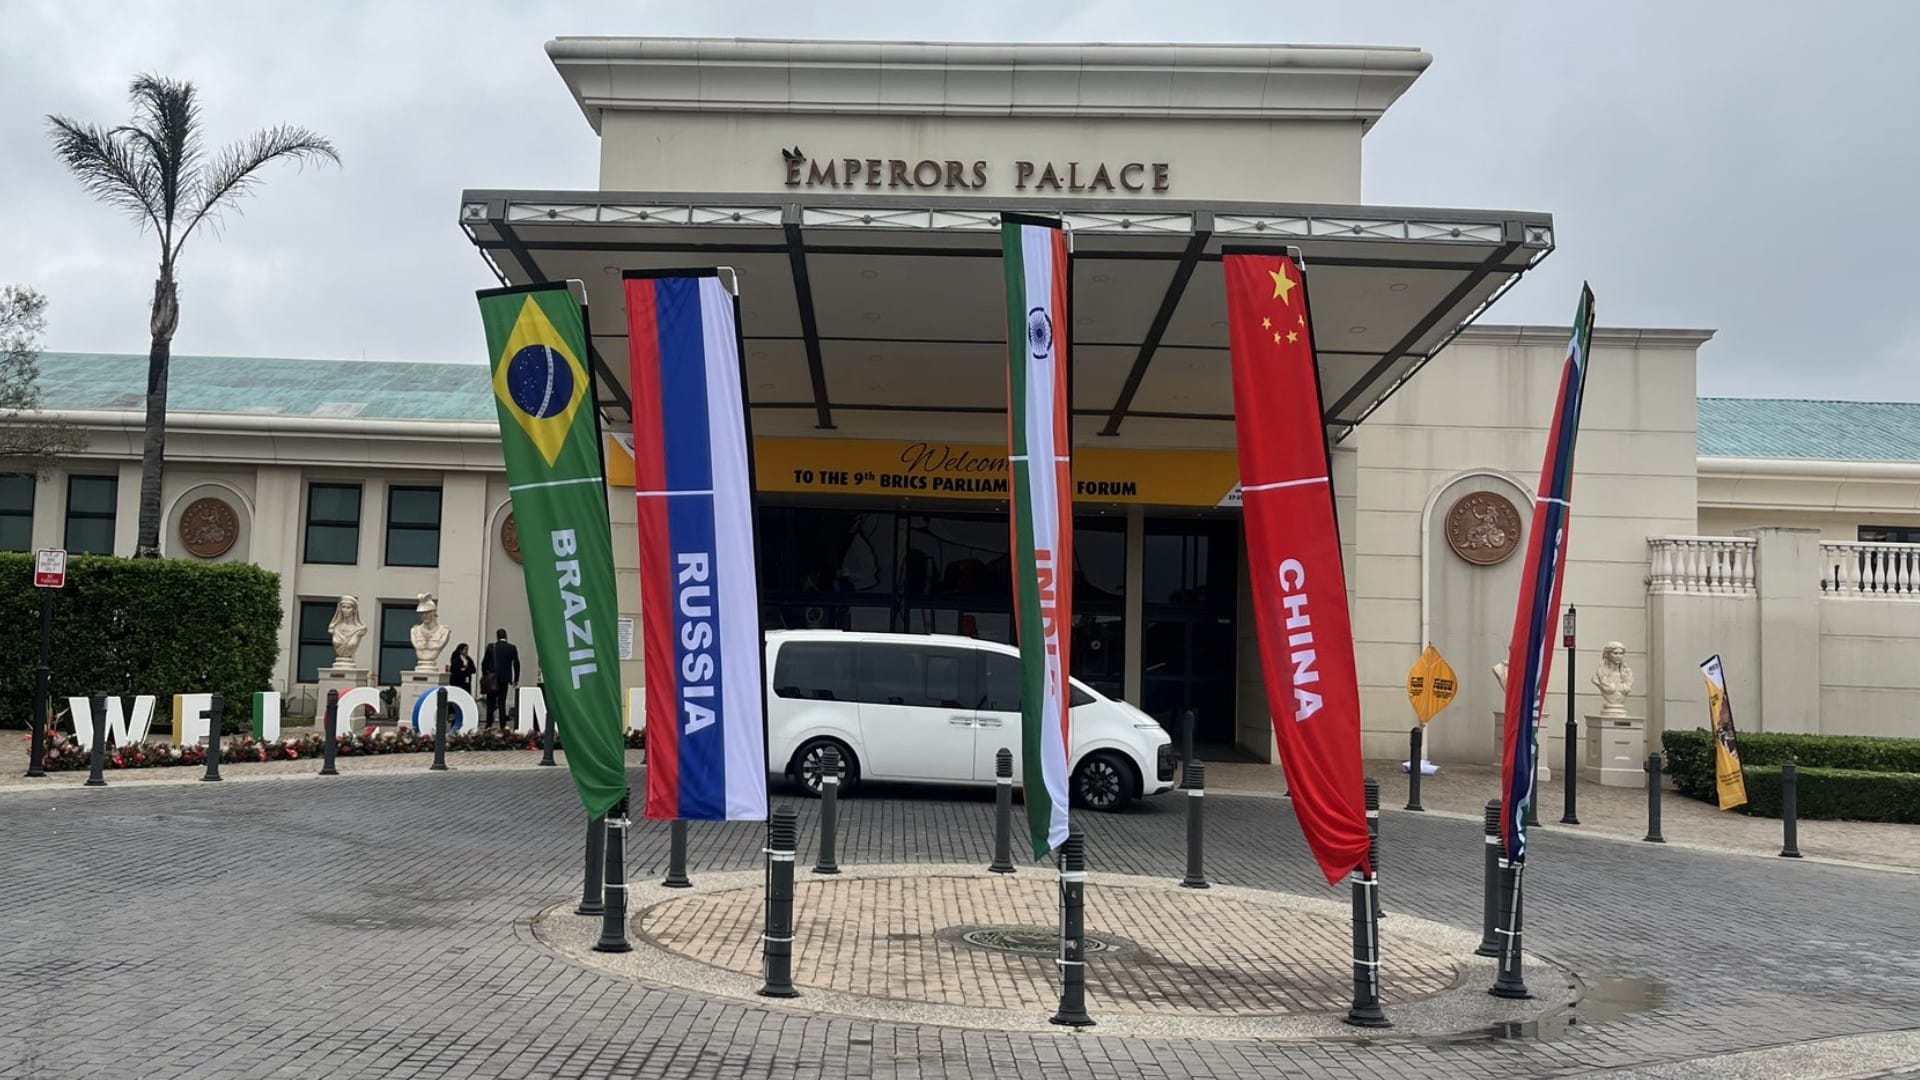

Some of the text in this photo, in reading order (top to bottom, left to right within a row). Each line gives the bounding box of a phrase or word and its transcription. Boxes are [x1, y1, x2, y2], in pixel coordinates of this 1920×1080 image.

[784, 157, 1170, 191] EMPERORS PALACE
[794, 470, 1137, 496] TO THE 9th BRICS PARLIAM FORUM
[901, 443, 1010, 473] Welcom
[551, 528, 597, 690] BRAZIL
[677, 552, 716, 735] RUSSIA
[1035, 549, 1057, 697] INDI
[1279, 558, 1324, 723] CHINA
